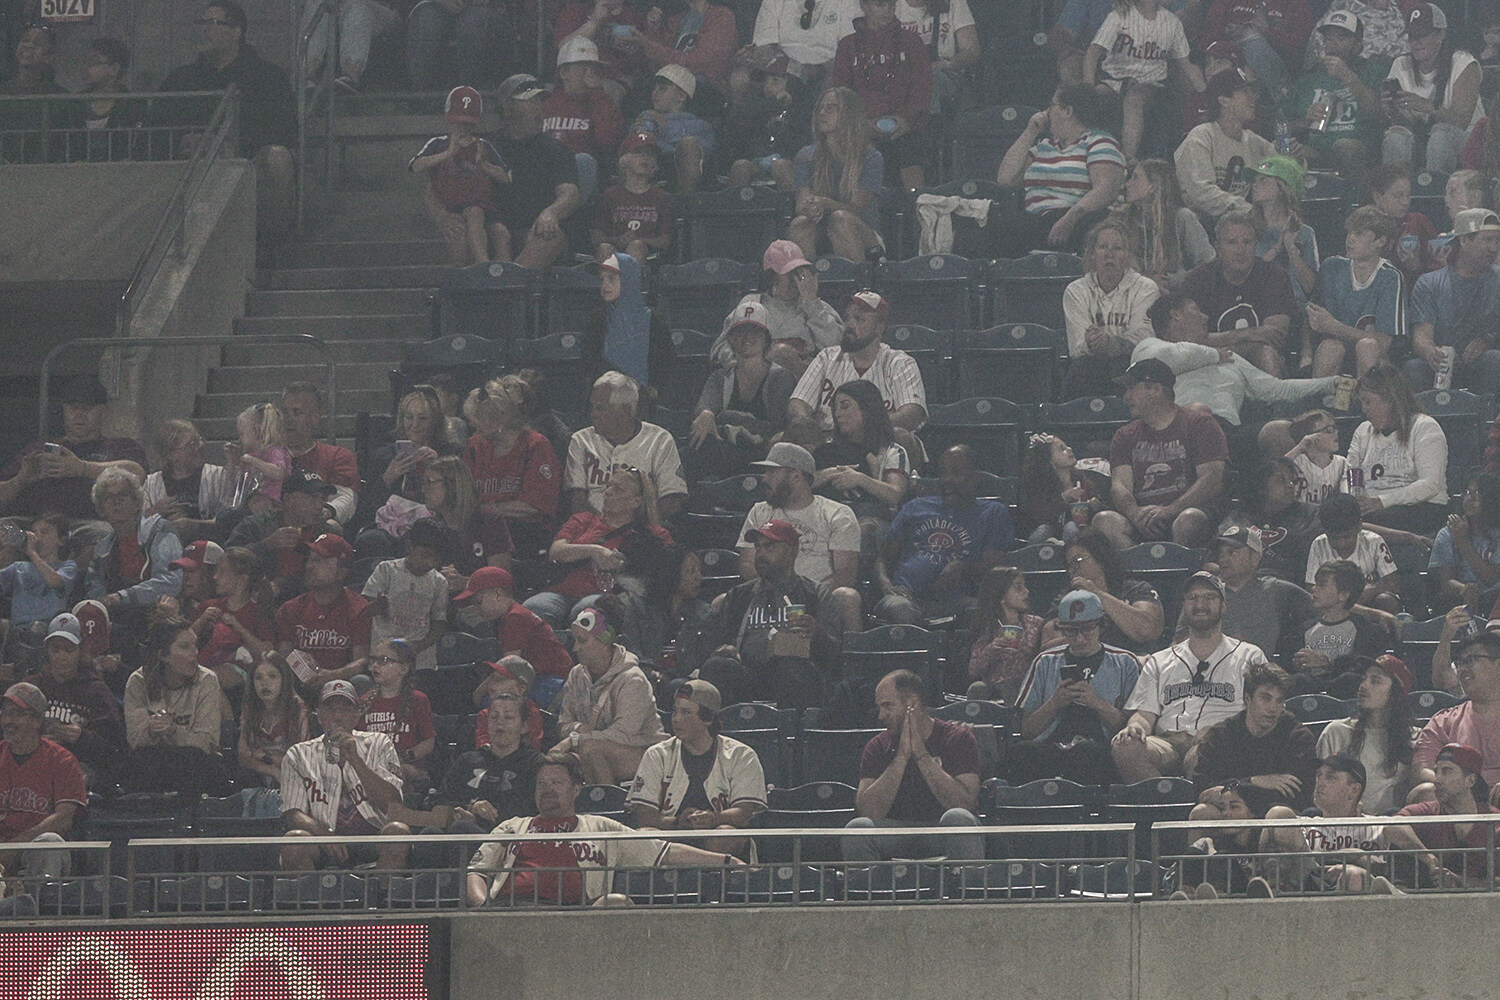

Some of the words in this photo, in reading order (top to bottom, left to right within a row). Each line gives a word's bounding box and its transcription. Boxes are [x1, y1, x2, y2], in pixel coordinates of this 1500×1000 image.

[1410, 9, 1421, 23] P
[463, 96, 472, 109] P
[745, 306, 755, 318] P
[1371, 463, 1384, 481] P
[1069, 600, 1086, 620] P
[86, 620, 96, 634] P
